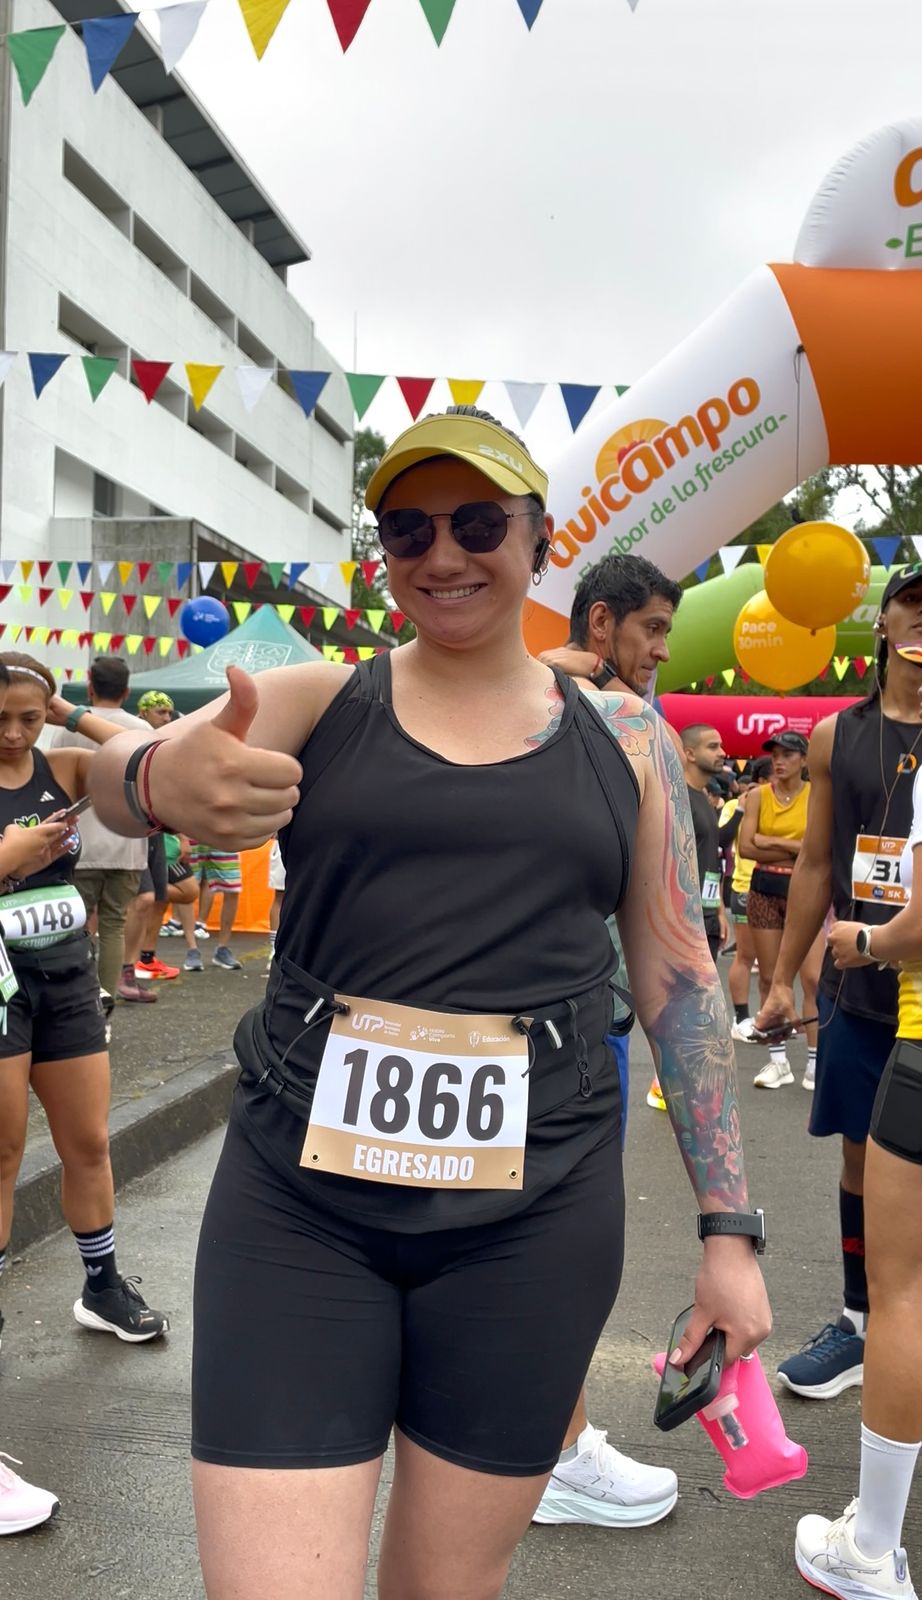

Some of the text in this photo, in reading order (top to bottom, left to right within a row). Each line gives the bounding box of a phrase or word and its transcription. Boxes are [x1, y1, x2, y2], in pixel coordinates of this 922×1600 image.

[478, 443, 523, 474] 2XU
[549, 377, 761, 569] avicampo
[602, 517, 650, 559] abor
[650, 497, 677, 525] de
[671, 479, 699, 503] la
[742, 620, 777, 635] Pace
[737, 713, 786, 736] UTP
[12, 900, 75, 937] 1148
[351, 1013, 385, 1034] UTP
[342, 1047, 507, 1143] 1866
[352, 1143, 476, 1183] EGRESADO
